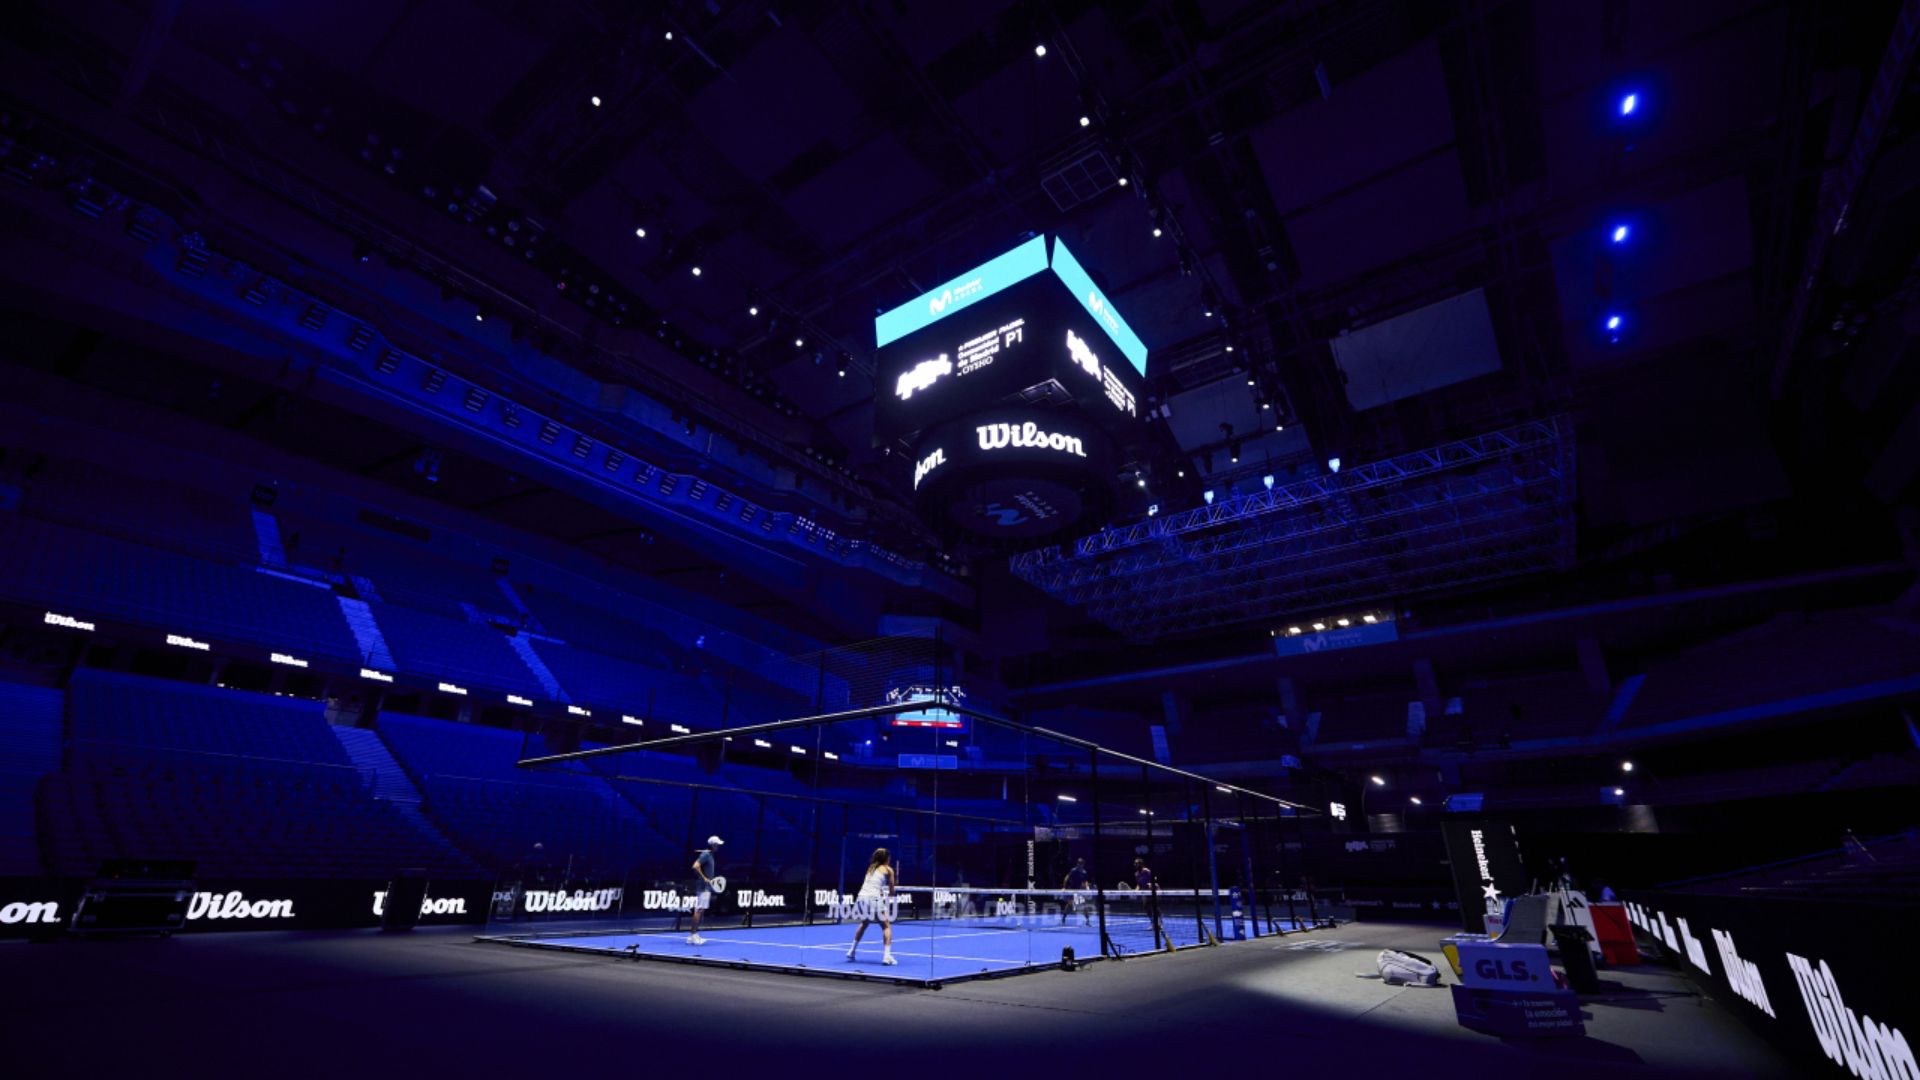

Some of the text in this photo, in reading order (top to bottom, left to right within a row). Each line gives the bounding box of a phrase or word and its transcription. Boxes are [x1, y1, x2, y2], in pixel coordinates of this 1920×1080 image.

[1005, 327, 1023, 348] P1
[976, 422, 1087, 457] Wilson
[1471, 830, 1491, 880] Heineken
